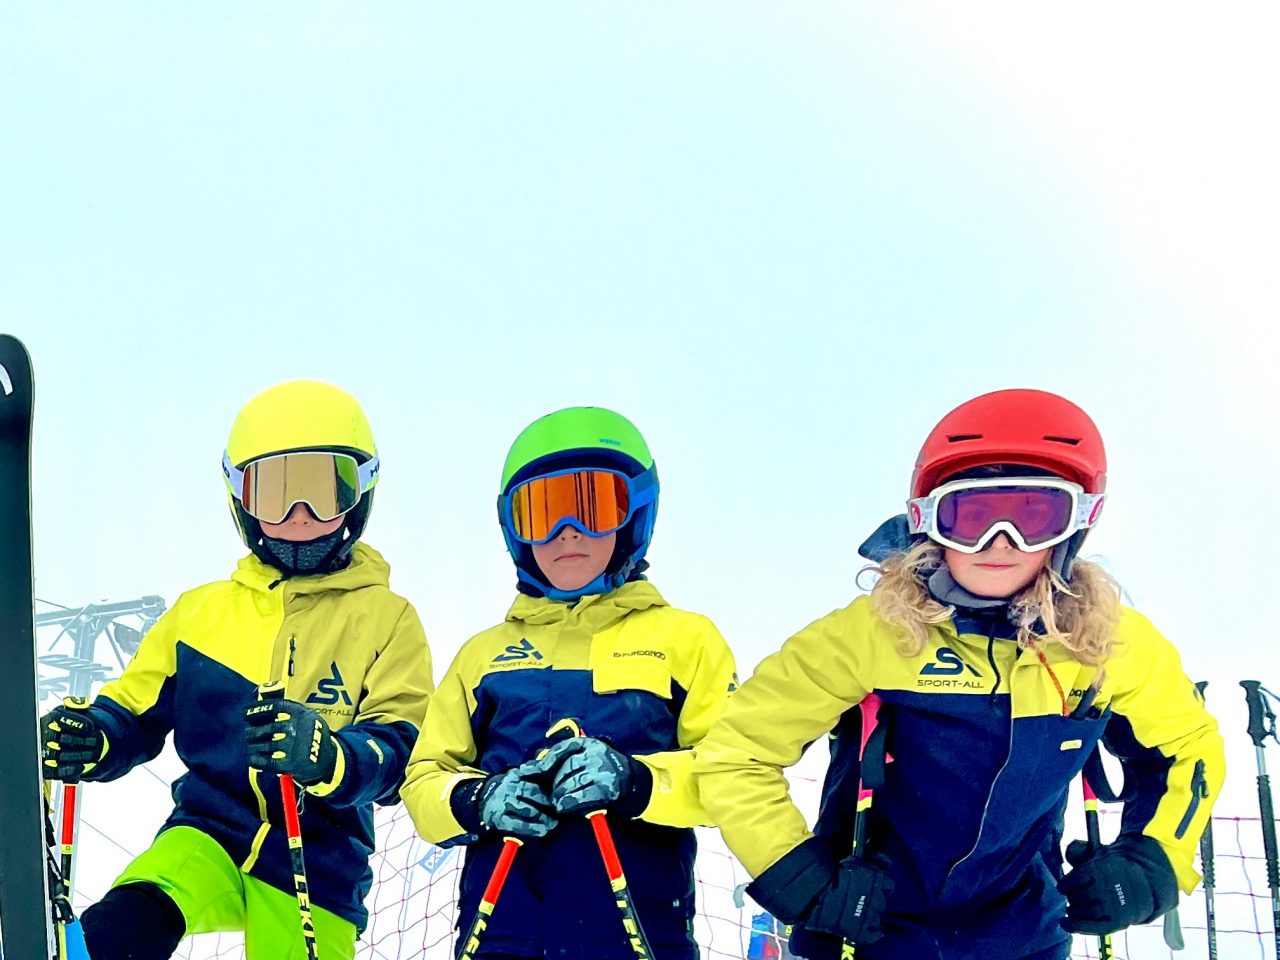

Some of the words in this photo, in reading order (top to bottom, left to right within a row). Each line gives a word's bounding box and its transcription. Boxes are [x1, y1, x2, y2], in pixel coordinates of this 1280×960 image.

[917, 679, 984, 689] SPORT-ALL
[246, 704, 274, 716] LEKI
[60, 716, 84, 729] LEKI
[309, 719, 323, 763] LEKI
[294, 873, 316, 938] LEKI
